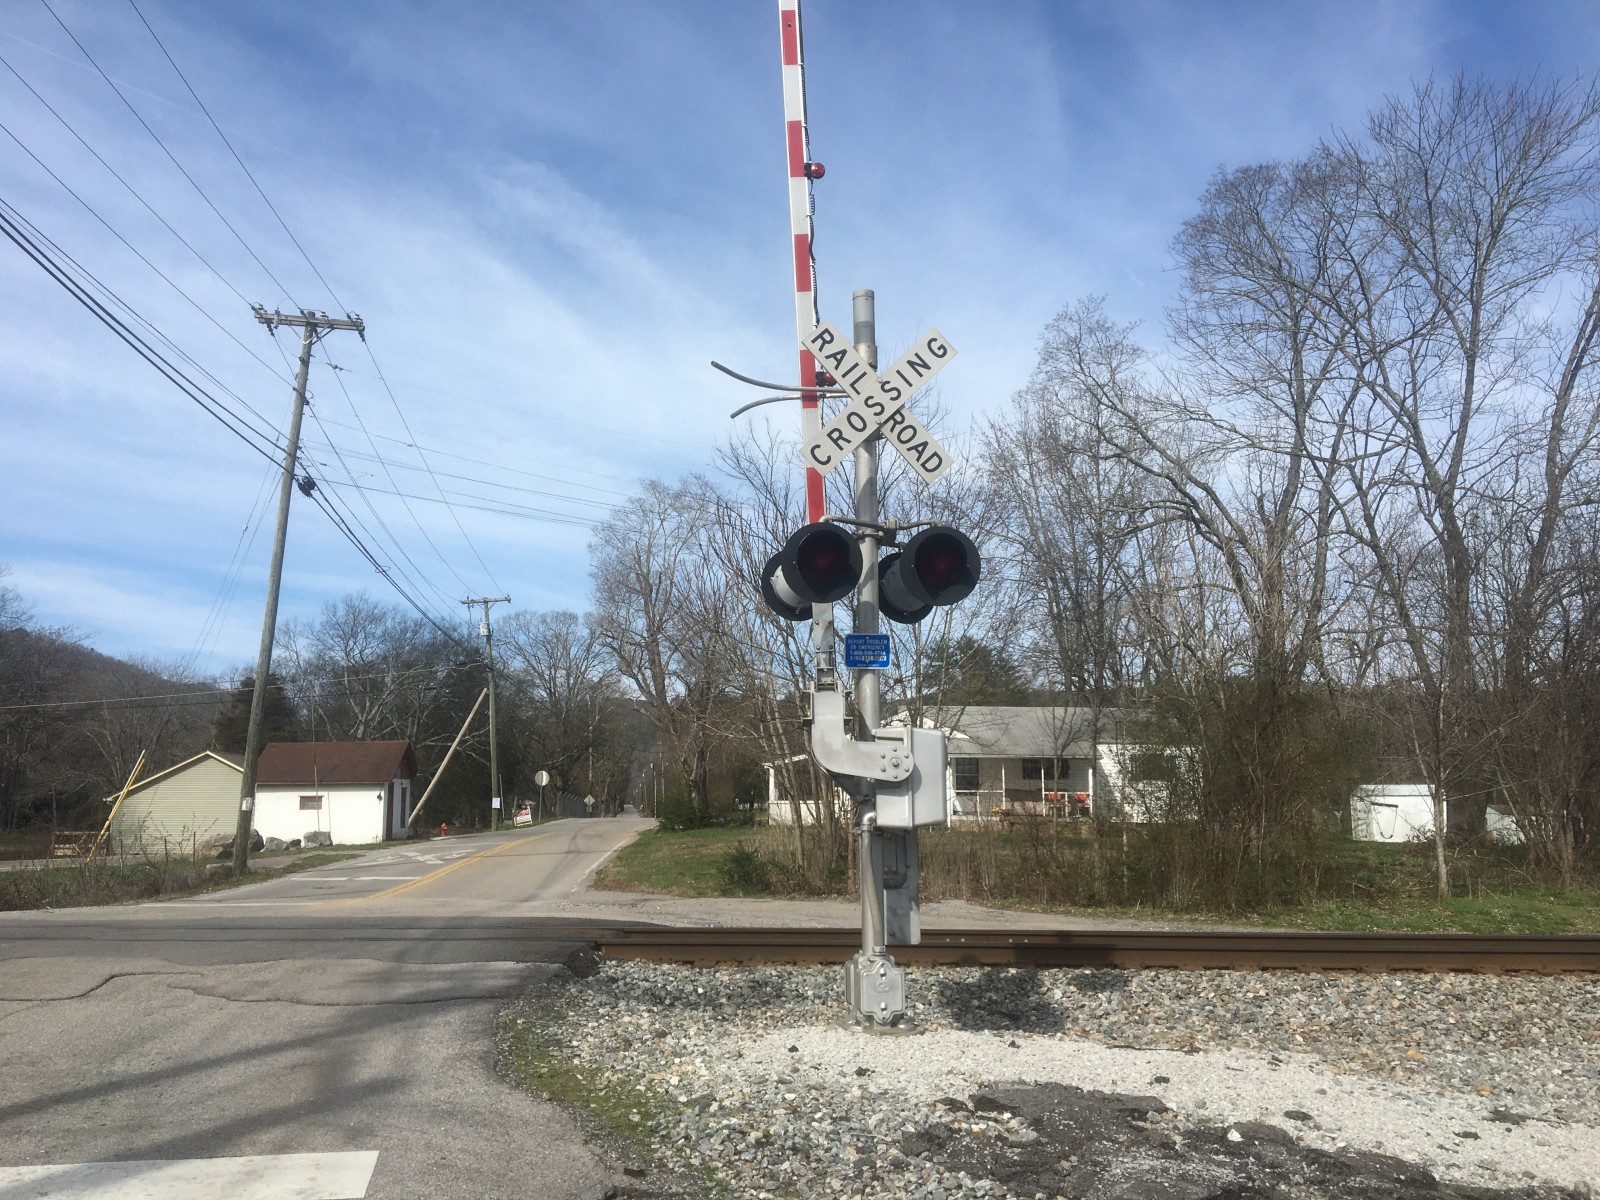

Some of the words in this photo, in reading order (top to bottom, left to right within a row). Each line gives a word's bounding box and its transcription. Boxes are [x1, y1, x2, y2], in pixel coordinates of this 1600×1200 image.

[810, 337, 948, 466] CROSSING
[811, 327, 868, 396] RAIL
[887, 408, 944, 474] ROAD
